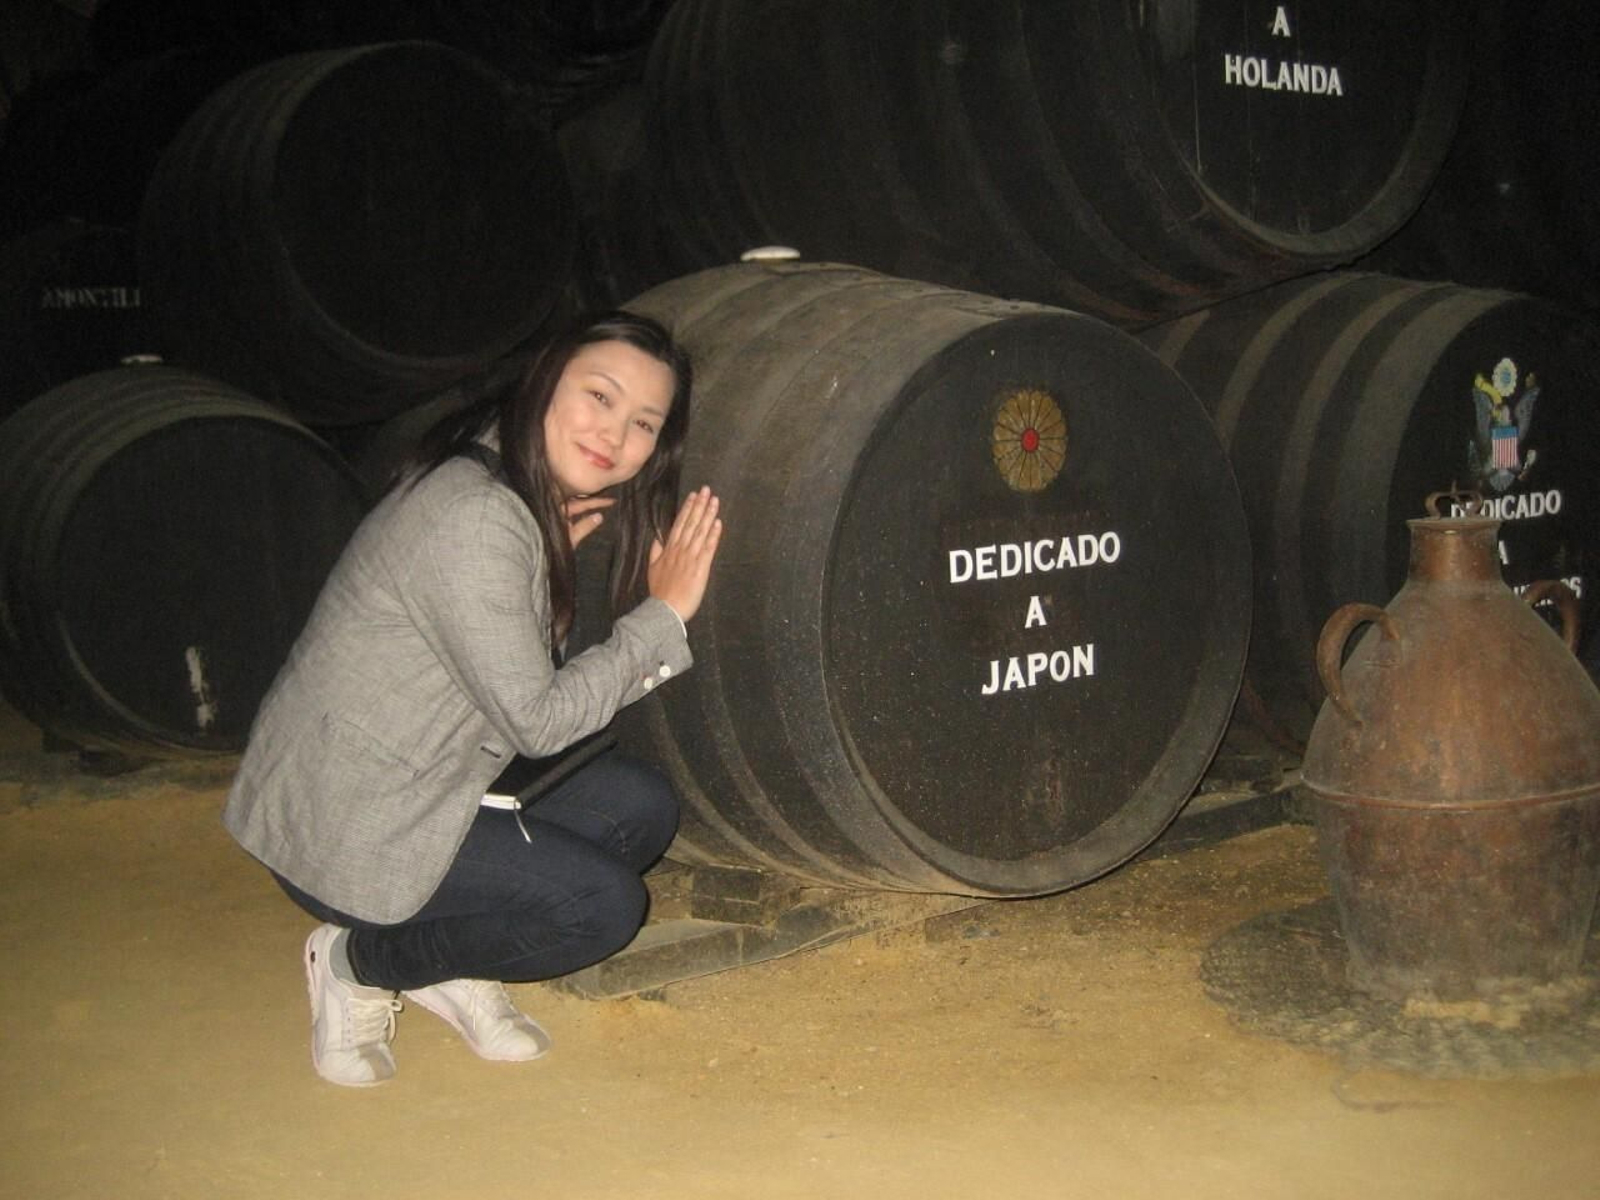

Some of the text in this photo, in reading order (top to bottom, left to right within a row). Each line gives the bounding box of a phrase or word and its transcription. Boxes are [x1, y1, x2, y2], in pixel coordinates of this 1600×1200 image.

[1271, 6, 1291, 37] A
[1224, 53, 1344, 97] HOLANDA
[1450, 488, 1563, 521] DDICADO
[948, 530, 1121, 584] DEDICADO
[1024, 595, 1048, 629] A
[980, 643, 1096, 696] JAPON
